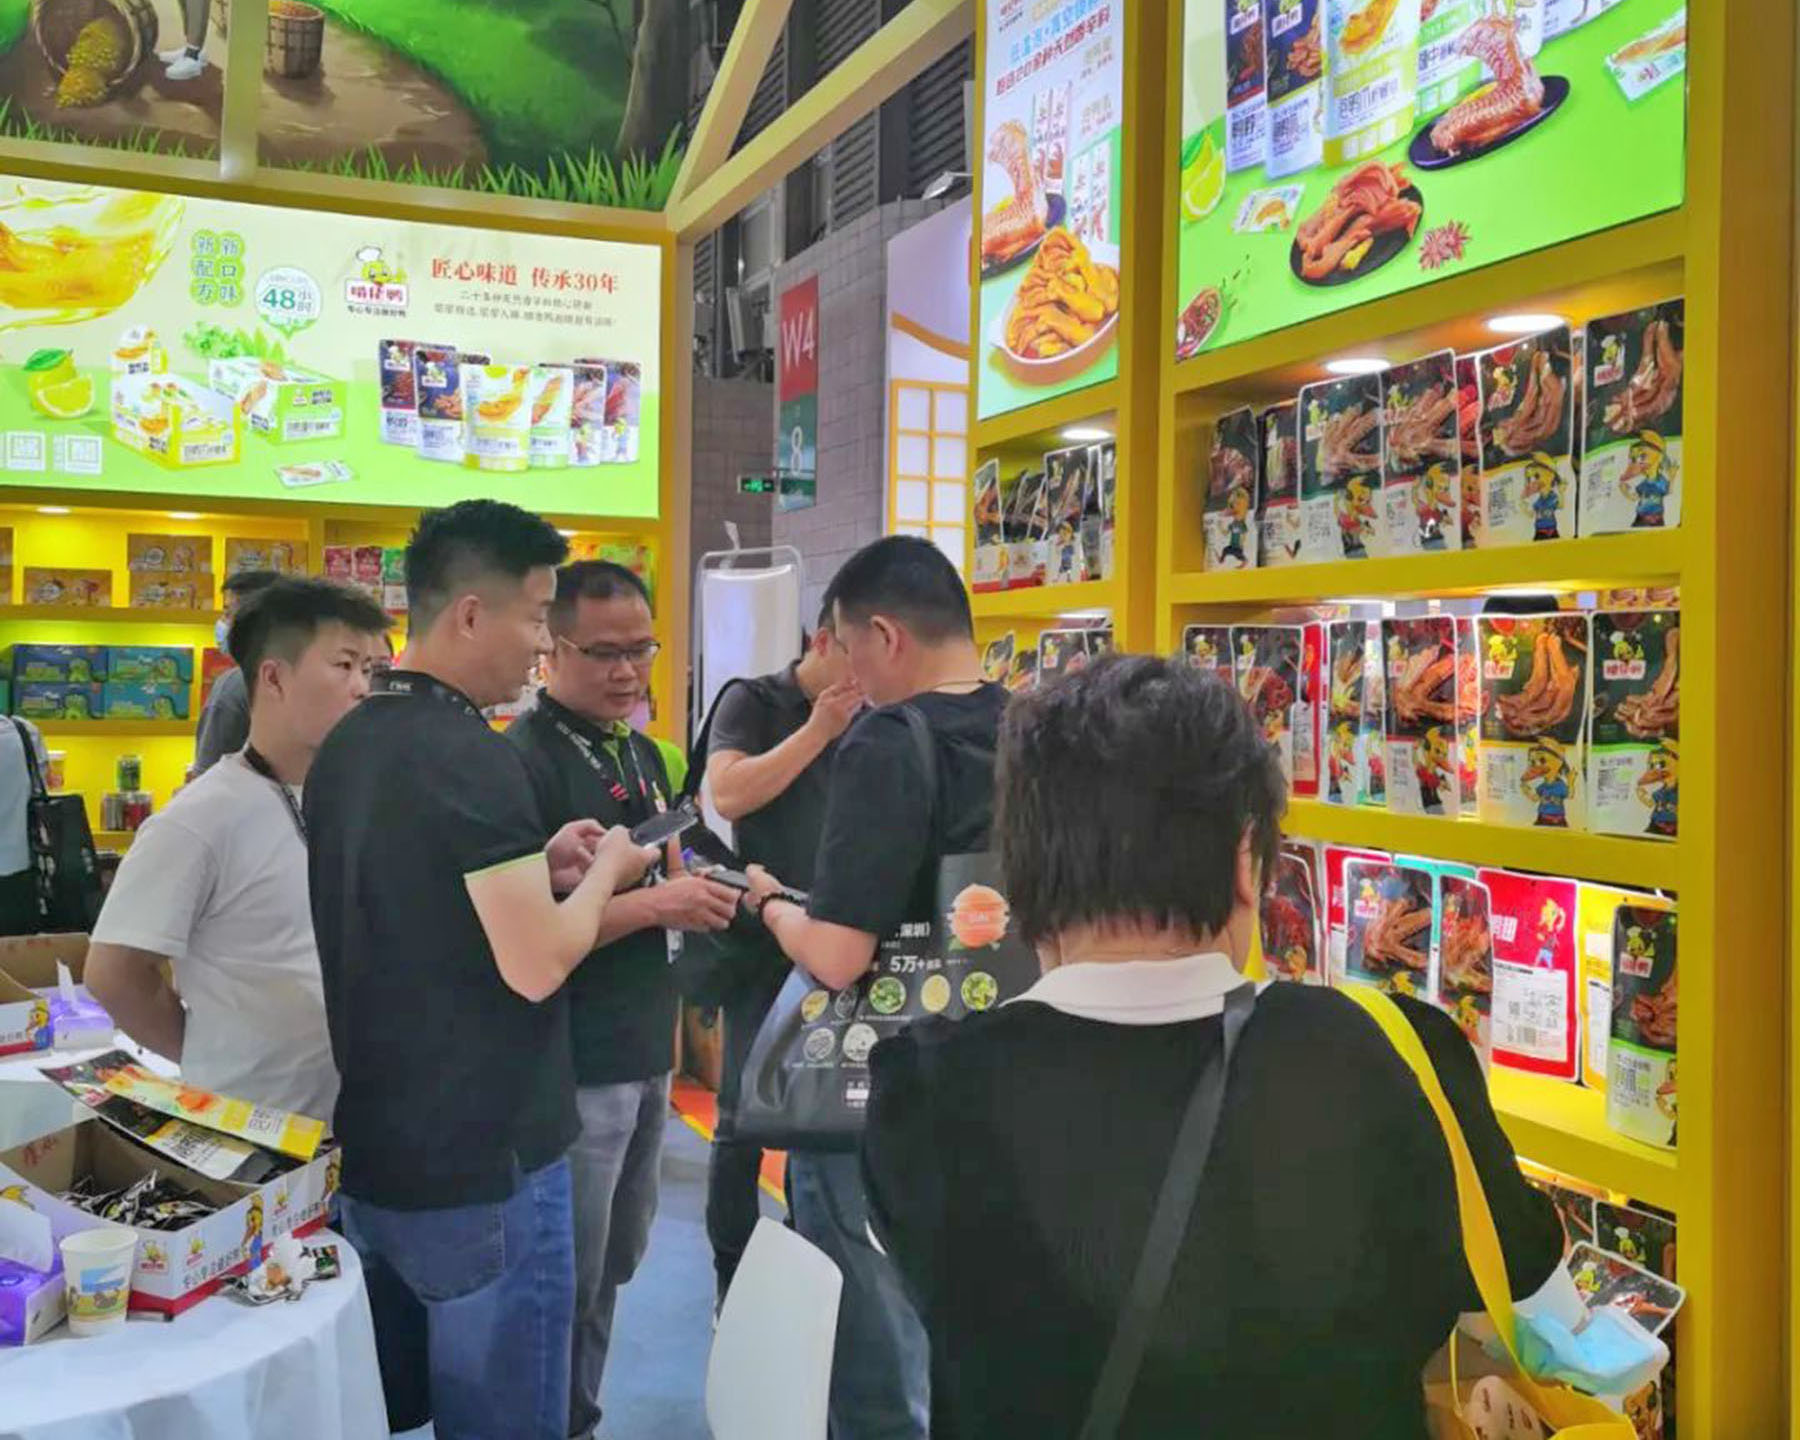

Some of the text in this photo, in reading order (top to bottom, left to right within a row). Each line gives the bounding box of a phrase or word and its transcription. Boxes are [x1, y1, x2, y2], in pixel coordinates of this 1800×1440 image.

[195, 236, 214, 299] 新配方
[220, 238, 237, 300] 新口味
[432, 258, 618, 294] 匠心味道 传承30年
[263, 288, 296, 310] 48
[782, 307, 816, 372] W4
[790, 425, 803, 477] 8
